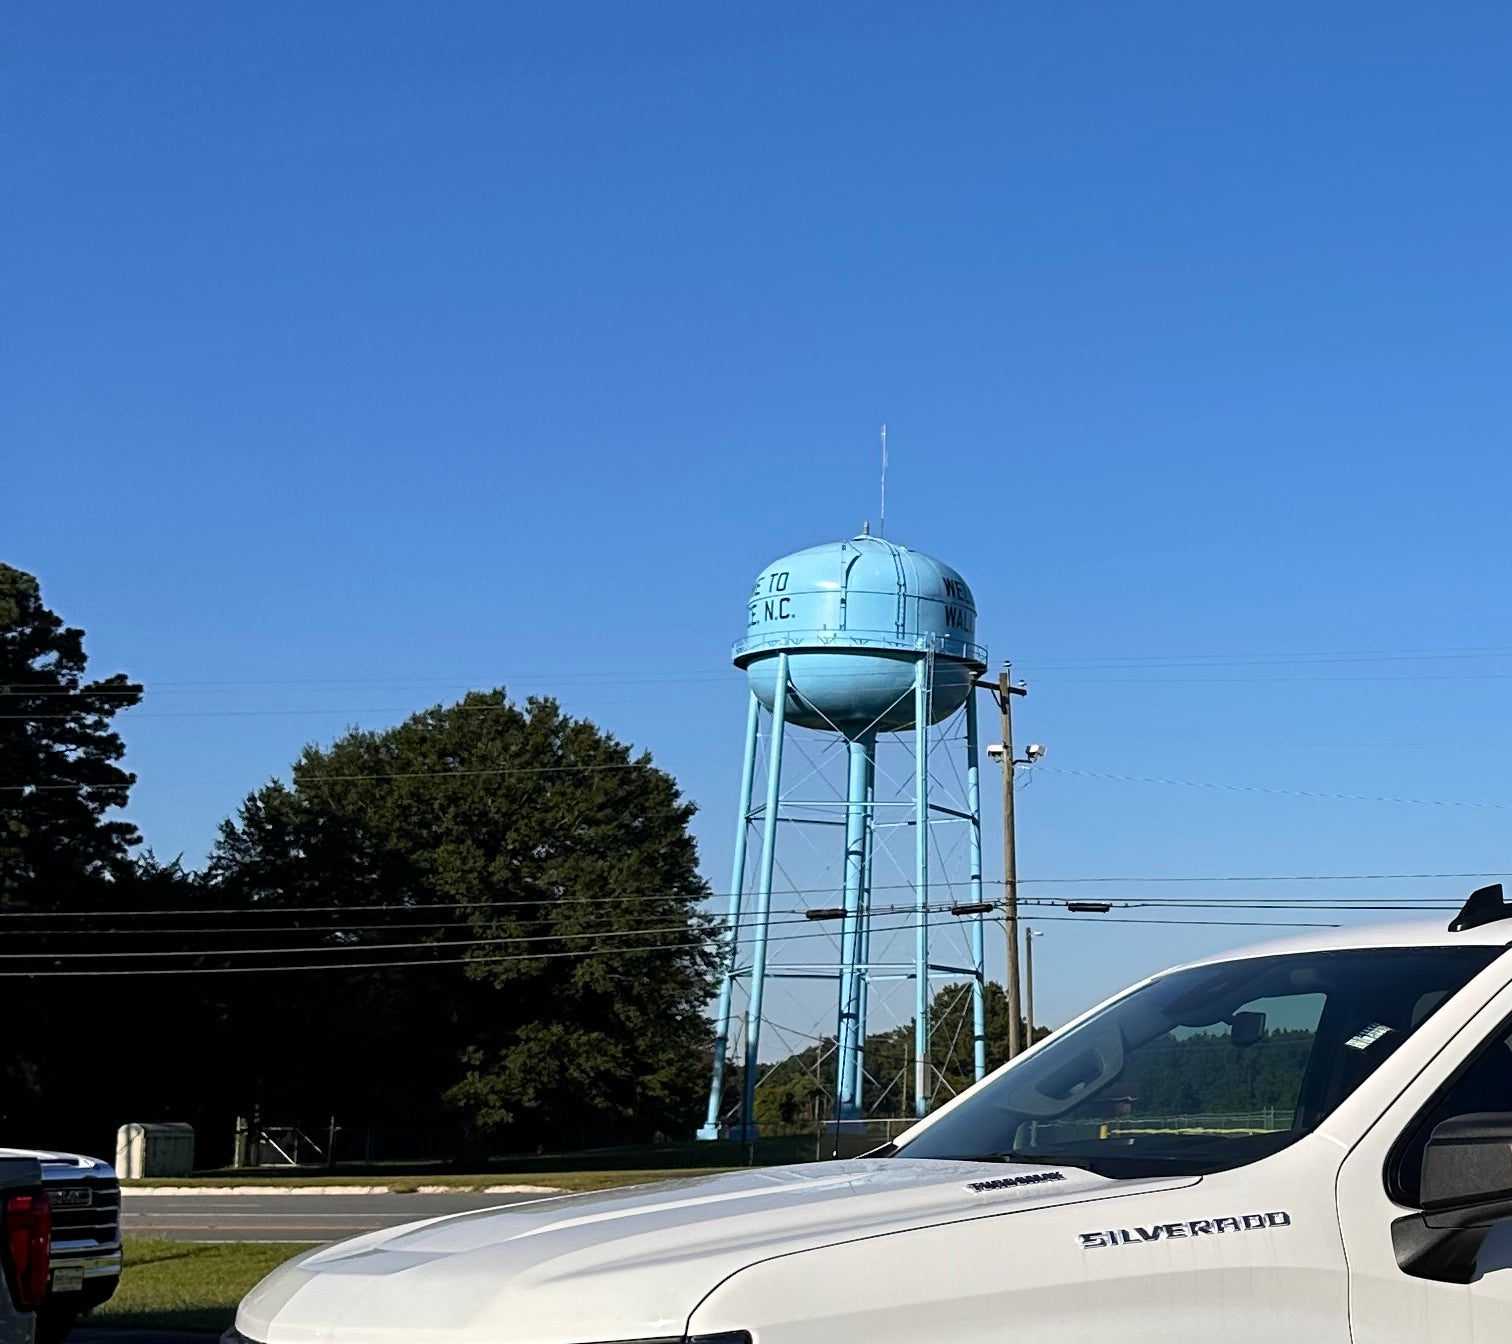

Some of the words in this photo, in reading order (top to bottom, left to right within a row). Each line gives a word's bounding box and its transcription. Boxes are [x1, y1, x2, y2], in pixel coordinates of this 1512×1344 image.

[769, 571, 790, 593] TO
[764, 597, 796, 622] N.C.
[1078, 1210, 1292, 1250] SILVERADO
